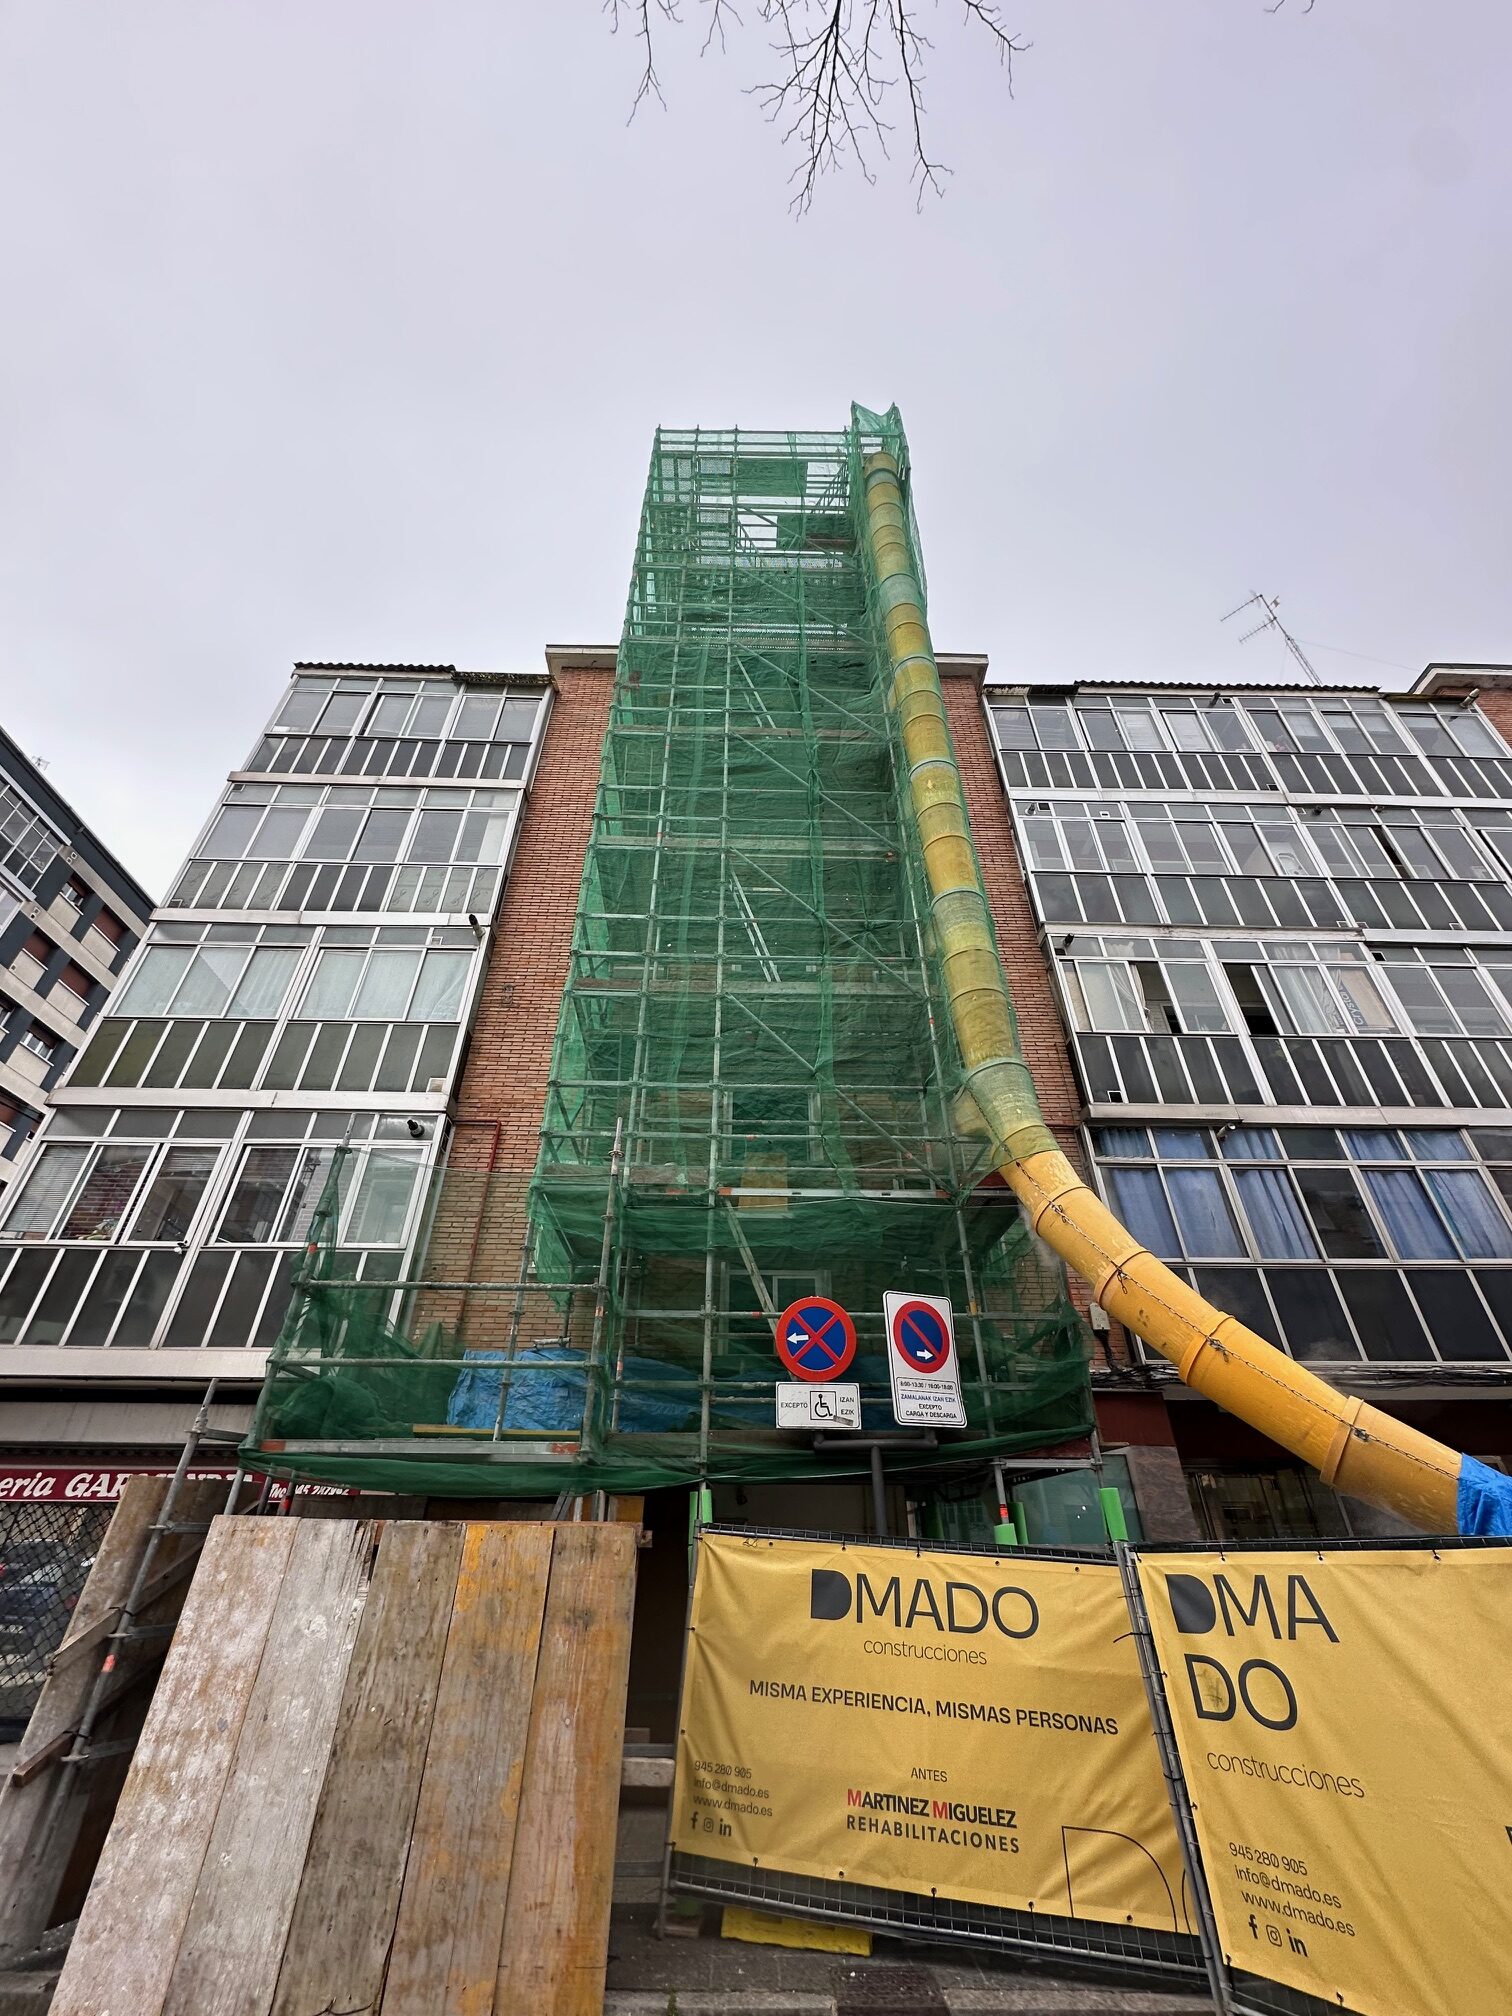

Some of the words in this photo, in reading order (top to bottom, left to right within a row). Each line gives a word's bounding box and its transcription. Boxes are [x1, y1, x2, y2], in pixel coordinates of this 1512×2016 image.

[905, 1410, 924, 1418] CARGA
[918, 1403, 943, 1411] EXCEPTO
[810, 1568, 1039, 1639] DMADO
[1164, 1573, 1341, 1643] DMA
[863, 1639, 988, 1665] construcciones
[749, 1679, 807, 1701] MISMA
[811, 1686, 931, 1717] EXPERIENCIA,
[936, 1700, 1011, 1724] MISMAS
[1016, 1708, 1120, 1735] PERSONAS
[1184, 1653, 1298, 1731] DO
[693, 1776, 770, 1799] info@dmado.es
[694, 1760, 714, 1773] 945
[714, 1763, 732, 1776] 280
[734, 1766, 752, 1779] 905
[910, 1767, 948, 1783] ANTES
[1206, 1752, 1365, 1798] construcciones
[692, 1794, 774, 1817] www.dmado.es
[847, 1788, 930, 1817] MARTINEZ
[932, 1800, 1018, 1829] MIGUELEZ
[846, 1814, 1020, 1854] REHABILITACIONES
[1229, 1842, 1254, 1861] 945
[1254, 1849, 1280, 1869] 280
[1281, 1856, 1308, 1876] 905
[1234, 1864, 1342, 1909] info@dmado.es
[1241, 1890, 1356, 1937] www.dmado.es
